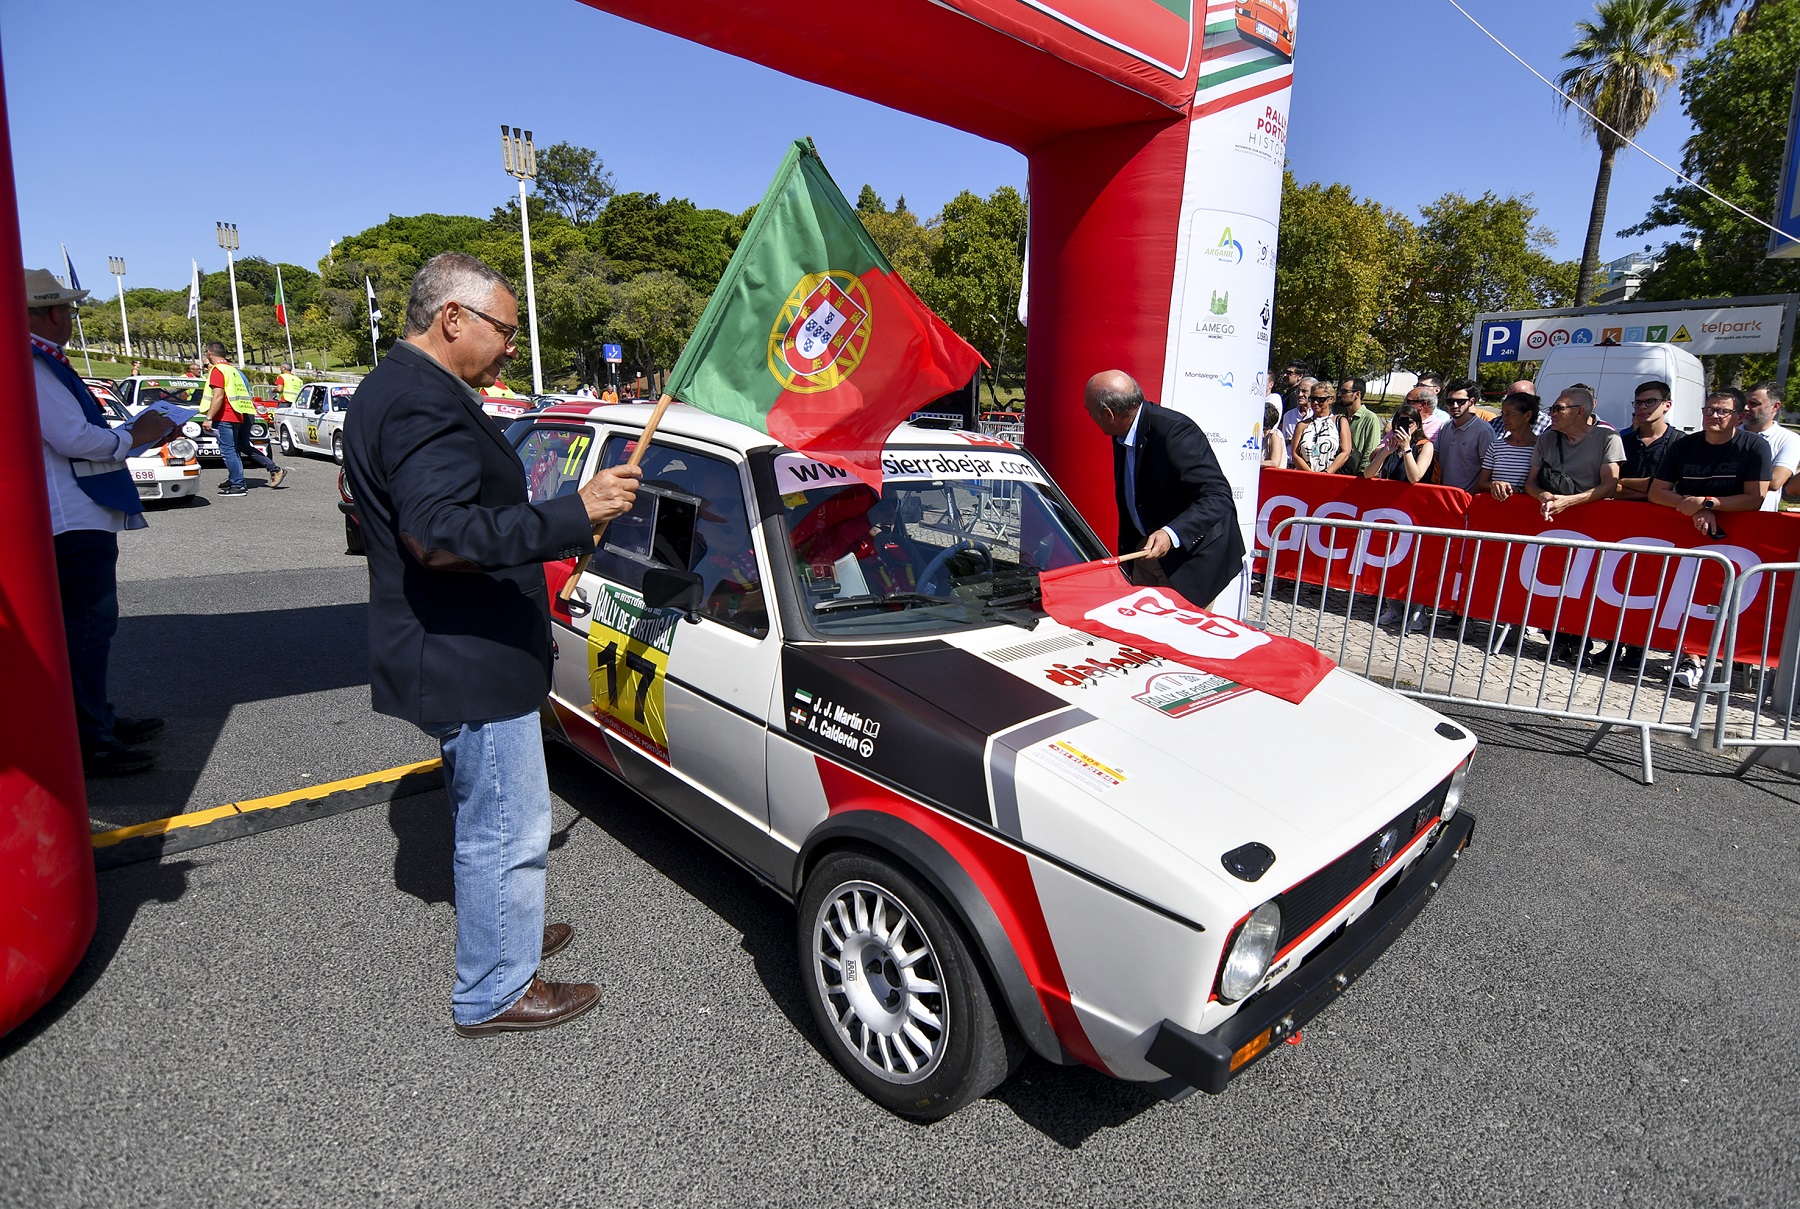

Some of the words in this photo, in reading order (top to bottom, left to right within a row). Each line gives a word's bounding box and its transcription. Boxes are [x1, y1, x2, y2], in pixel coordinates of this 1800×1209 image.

[1204, 248, 1233, 258] ARGANIL
[1195, 322, 1235, 334] LAMEGO
[1701, 320, 1763, 335] telpark
[1486, 326, 1511, 356] P
[1500, 348, 1515, 356] 24h
[1184, 371, 1219, 380] Montalegre
[308, 427, 318, 440] 23
[563, 435, 591, 477] 17
[1683, 462, 1739, 475] FRACE
[1256, 495, 1414, 576] acp
[1519, 529, 1764, 630] acp
[593, 584, 620, 628] RALLY
[616, 608, 630, 633] DE
[627, 613, 679, 653] PORTUGAL
[598, 641, 658, 725] 17
[1137, 691, 1179, 708] RALLY
[1175, 689, 1191, 698] DE
[813, 697, 822, 714] J.
[823, 701, 833, 719] J.
[833, 705, 863, 731] Martín
[808, 715, 819, 733] A.
[819, 720, 859, 751] Calderón
[1080, 754, 1101, 767] SOS
